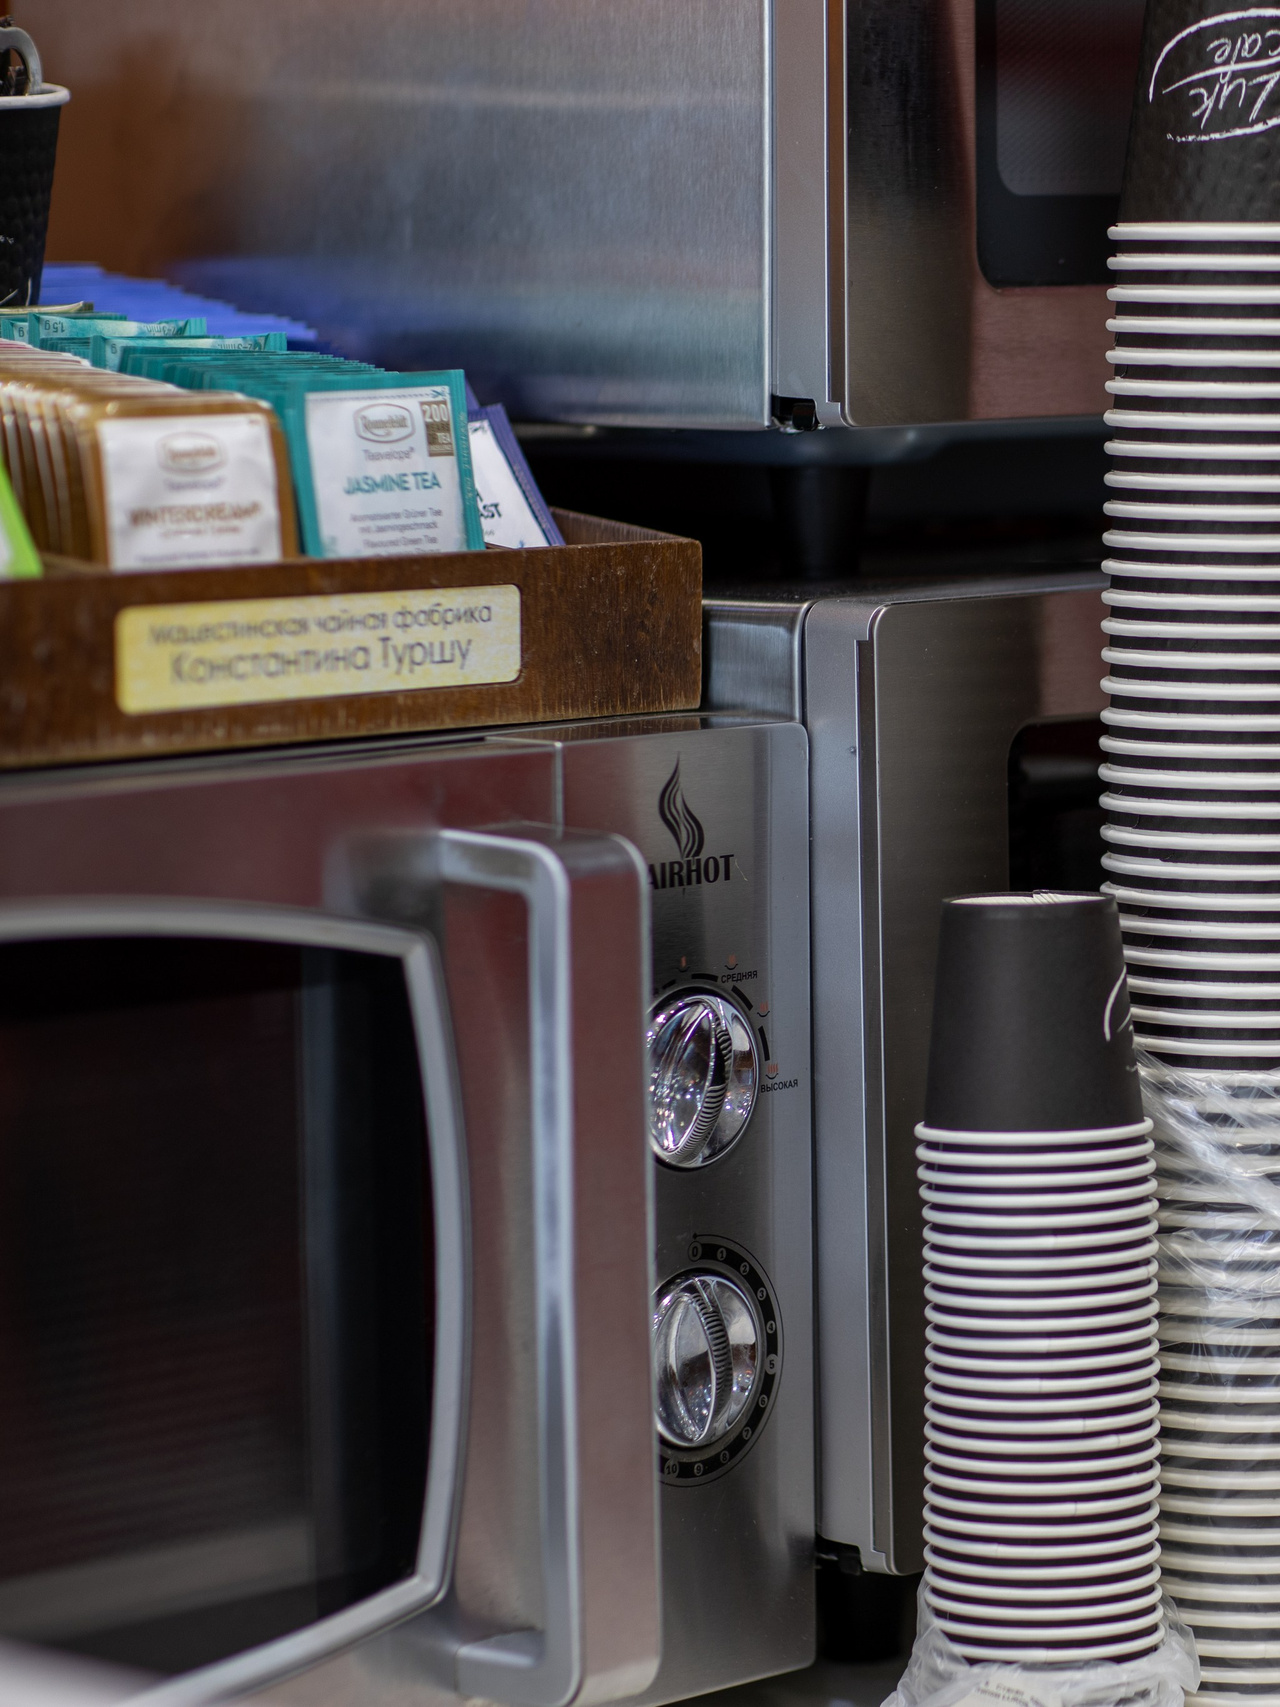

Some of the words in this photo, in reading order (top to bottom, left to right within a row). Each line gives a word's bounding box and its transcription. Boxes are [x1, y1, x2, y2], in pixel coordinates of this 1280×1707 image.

[44, 320, 51, 332] g
[422, 404, 448, 423] 200
[344, 473, 408, 495] JASMINE
[414, 472, 442, 490] TEA
[314, 609, 389, 635] чайная
[393, 603, 492, 633] фабрика
[171, 645, 371, 685] Константина
[377, 636, 473, 675] Туршу
[721, 970, 758, 984] СРЕДНЯЯ
[760, 1079, 799, 1093] ВЫСОКАЯ
